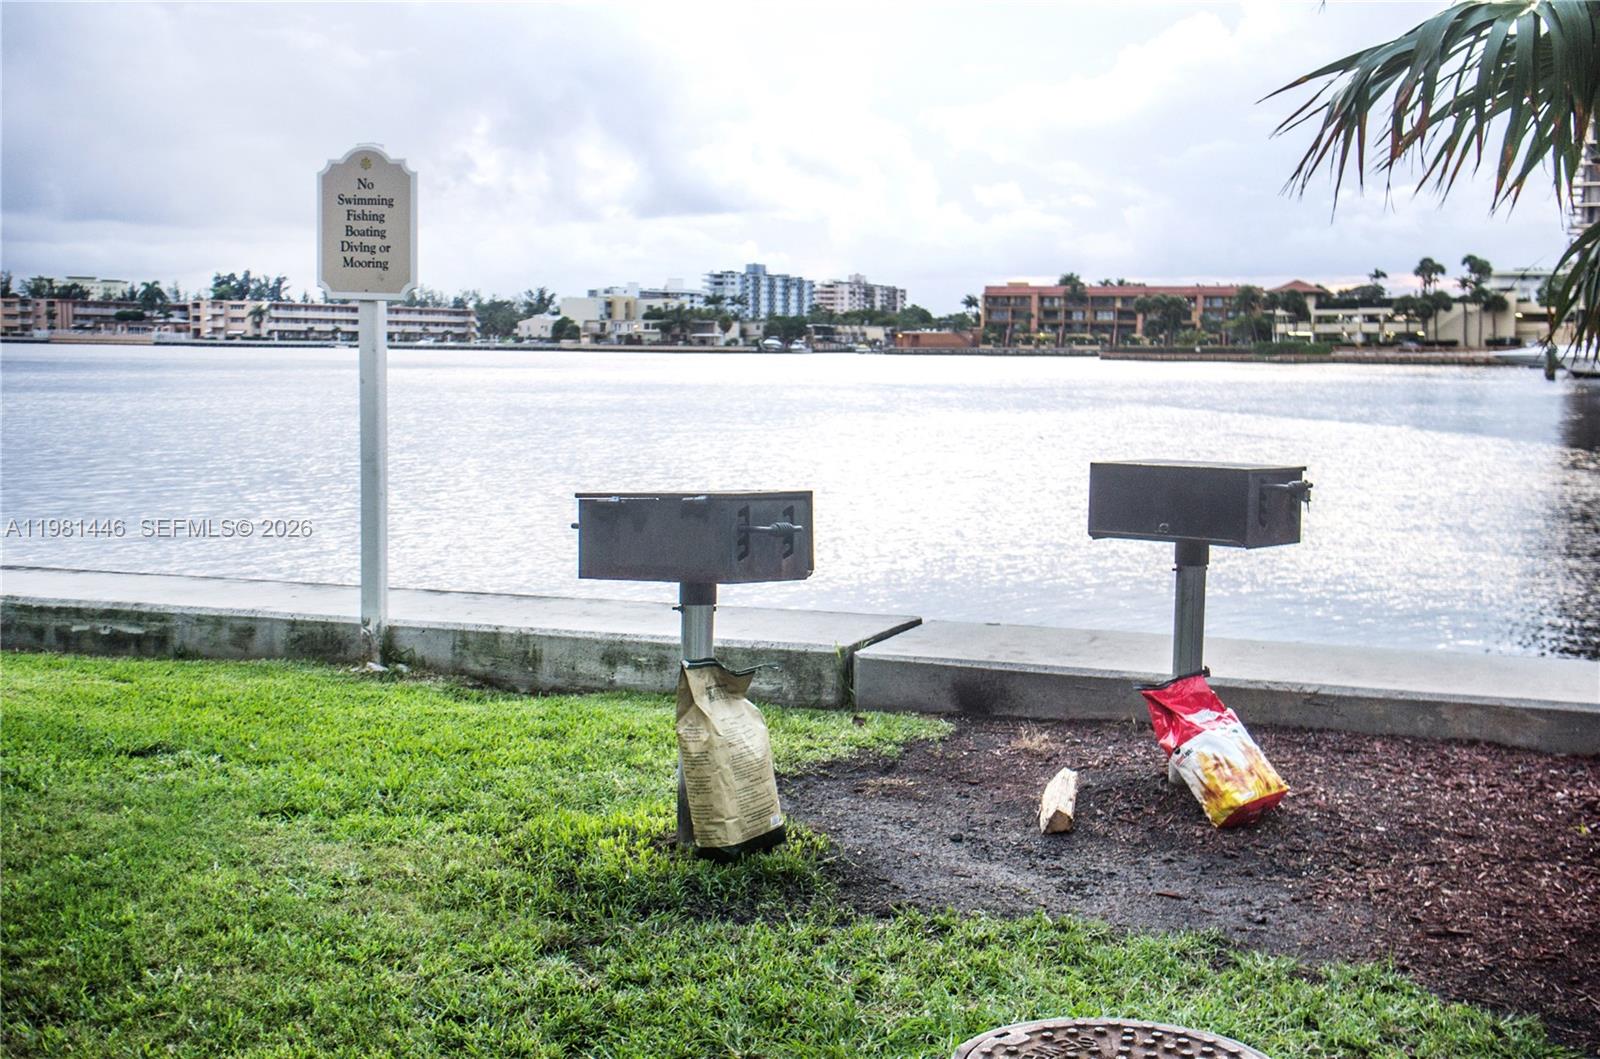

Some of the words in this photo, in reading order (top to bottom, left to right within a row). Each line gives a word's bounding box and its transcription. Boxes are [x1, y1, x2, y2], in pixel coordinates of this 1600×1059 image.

[357, 178, 374, 190] No
[337, 194, 394, 208] Swimming
[346, 209, 385, 223] Fishing
[345, 225, 386, 239] Boating
[340, 241, 376, 255] Diving
[379, 244, 391, 252] or
[343, 256, 389, 270] Mooring
